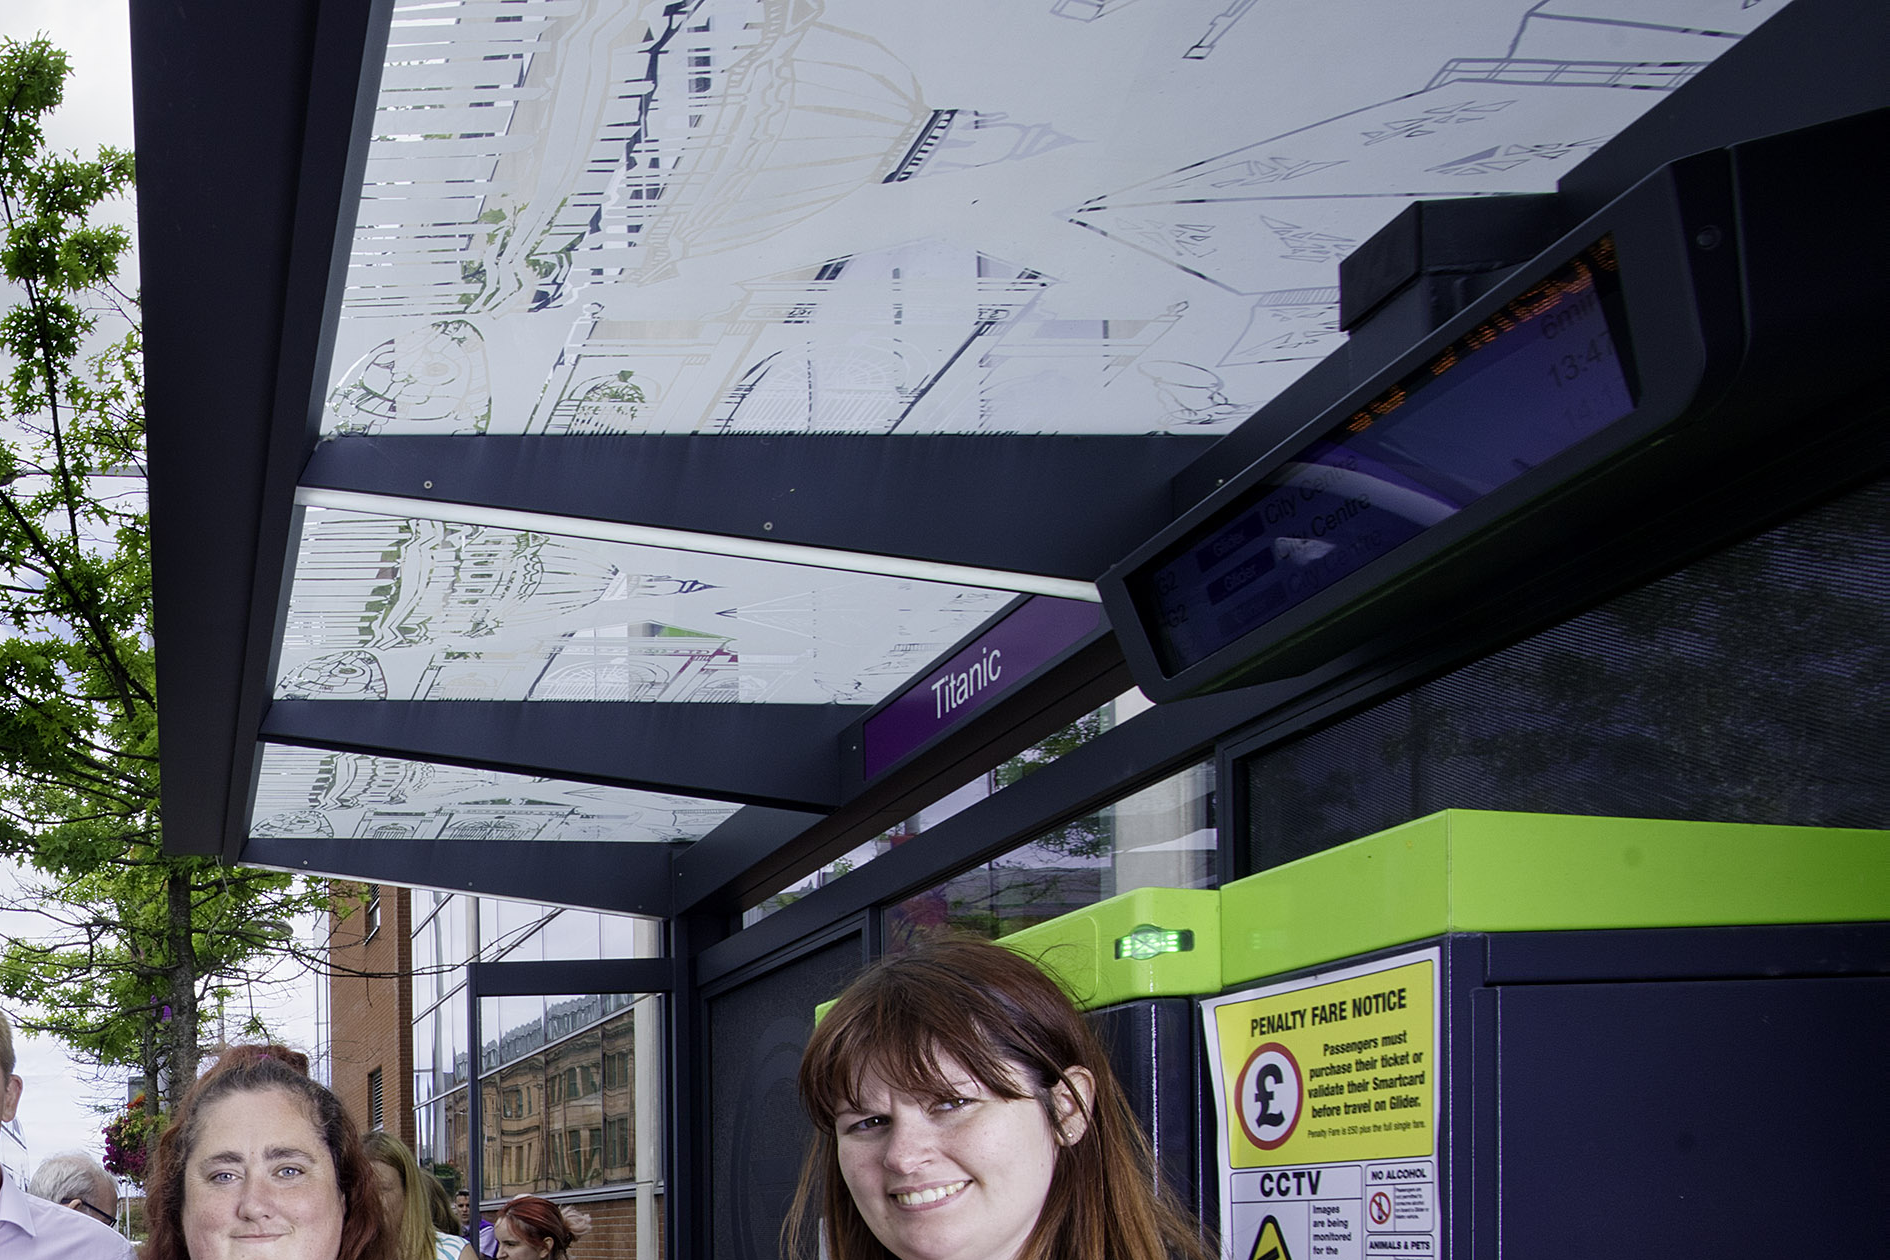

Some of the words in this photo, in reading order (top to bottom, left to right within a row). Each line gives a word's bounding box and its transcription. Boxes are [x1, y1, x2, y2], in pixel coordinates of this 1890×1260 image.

[1264, 496, 1298, 525] City
[1312, 493, 1371, 538] Centre
[931, 646, 1002, 719] Titanic
[1250, 1008, 1307, 1037] PENALTY
[1311, 1001, 1347, 1026] FARE
[1352, 988, 1407, 1018] NOTICE
[1323, 1036, 1379, 1056] Passengers
[1381, 1030, 1407, 1047] must
[1309, 1063, 1353, 1081] purchase
[1355, 1057, 1378, 1073] their
[1381, 1052, 1409, 1068] ticket
[1412, 1051, 1423, 1064] or
[1307, 1083, 1345, 1099] validate
[1347, 1079, 1370, 1094] their
[1372, 1070, 1426, 1091] Smartcard
[1311, 1104, 1341, 1119] before
[1344, 1099, 1371, 1115] travel
[1374, 1099, 1386, 1112] on
[1389, 1094, 1421, 1110] Glider.
[1260, 1170, 1321, 1197] CCTV
[1371, 1171, 1383, 1181] NO
[1385, 1168, 1427, 1180] ALCOHOL
[1313, 1205, 1340, 1216] Images
[1313, 1220, 1325, 1228] are
[1327, 1218, 1349, 1230] being
[1313, 1232, 1352, 1242] monitored
[1313, 1246, 1324, 1255] for
[1326, 1246, 1338, 1255] the
[1369, 1241, 1402, 1250] ANIMALS
[1403, 1241, 1409, 1250] &
[1411, 1241, 1431, 1250] PETS
